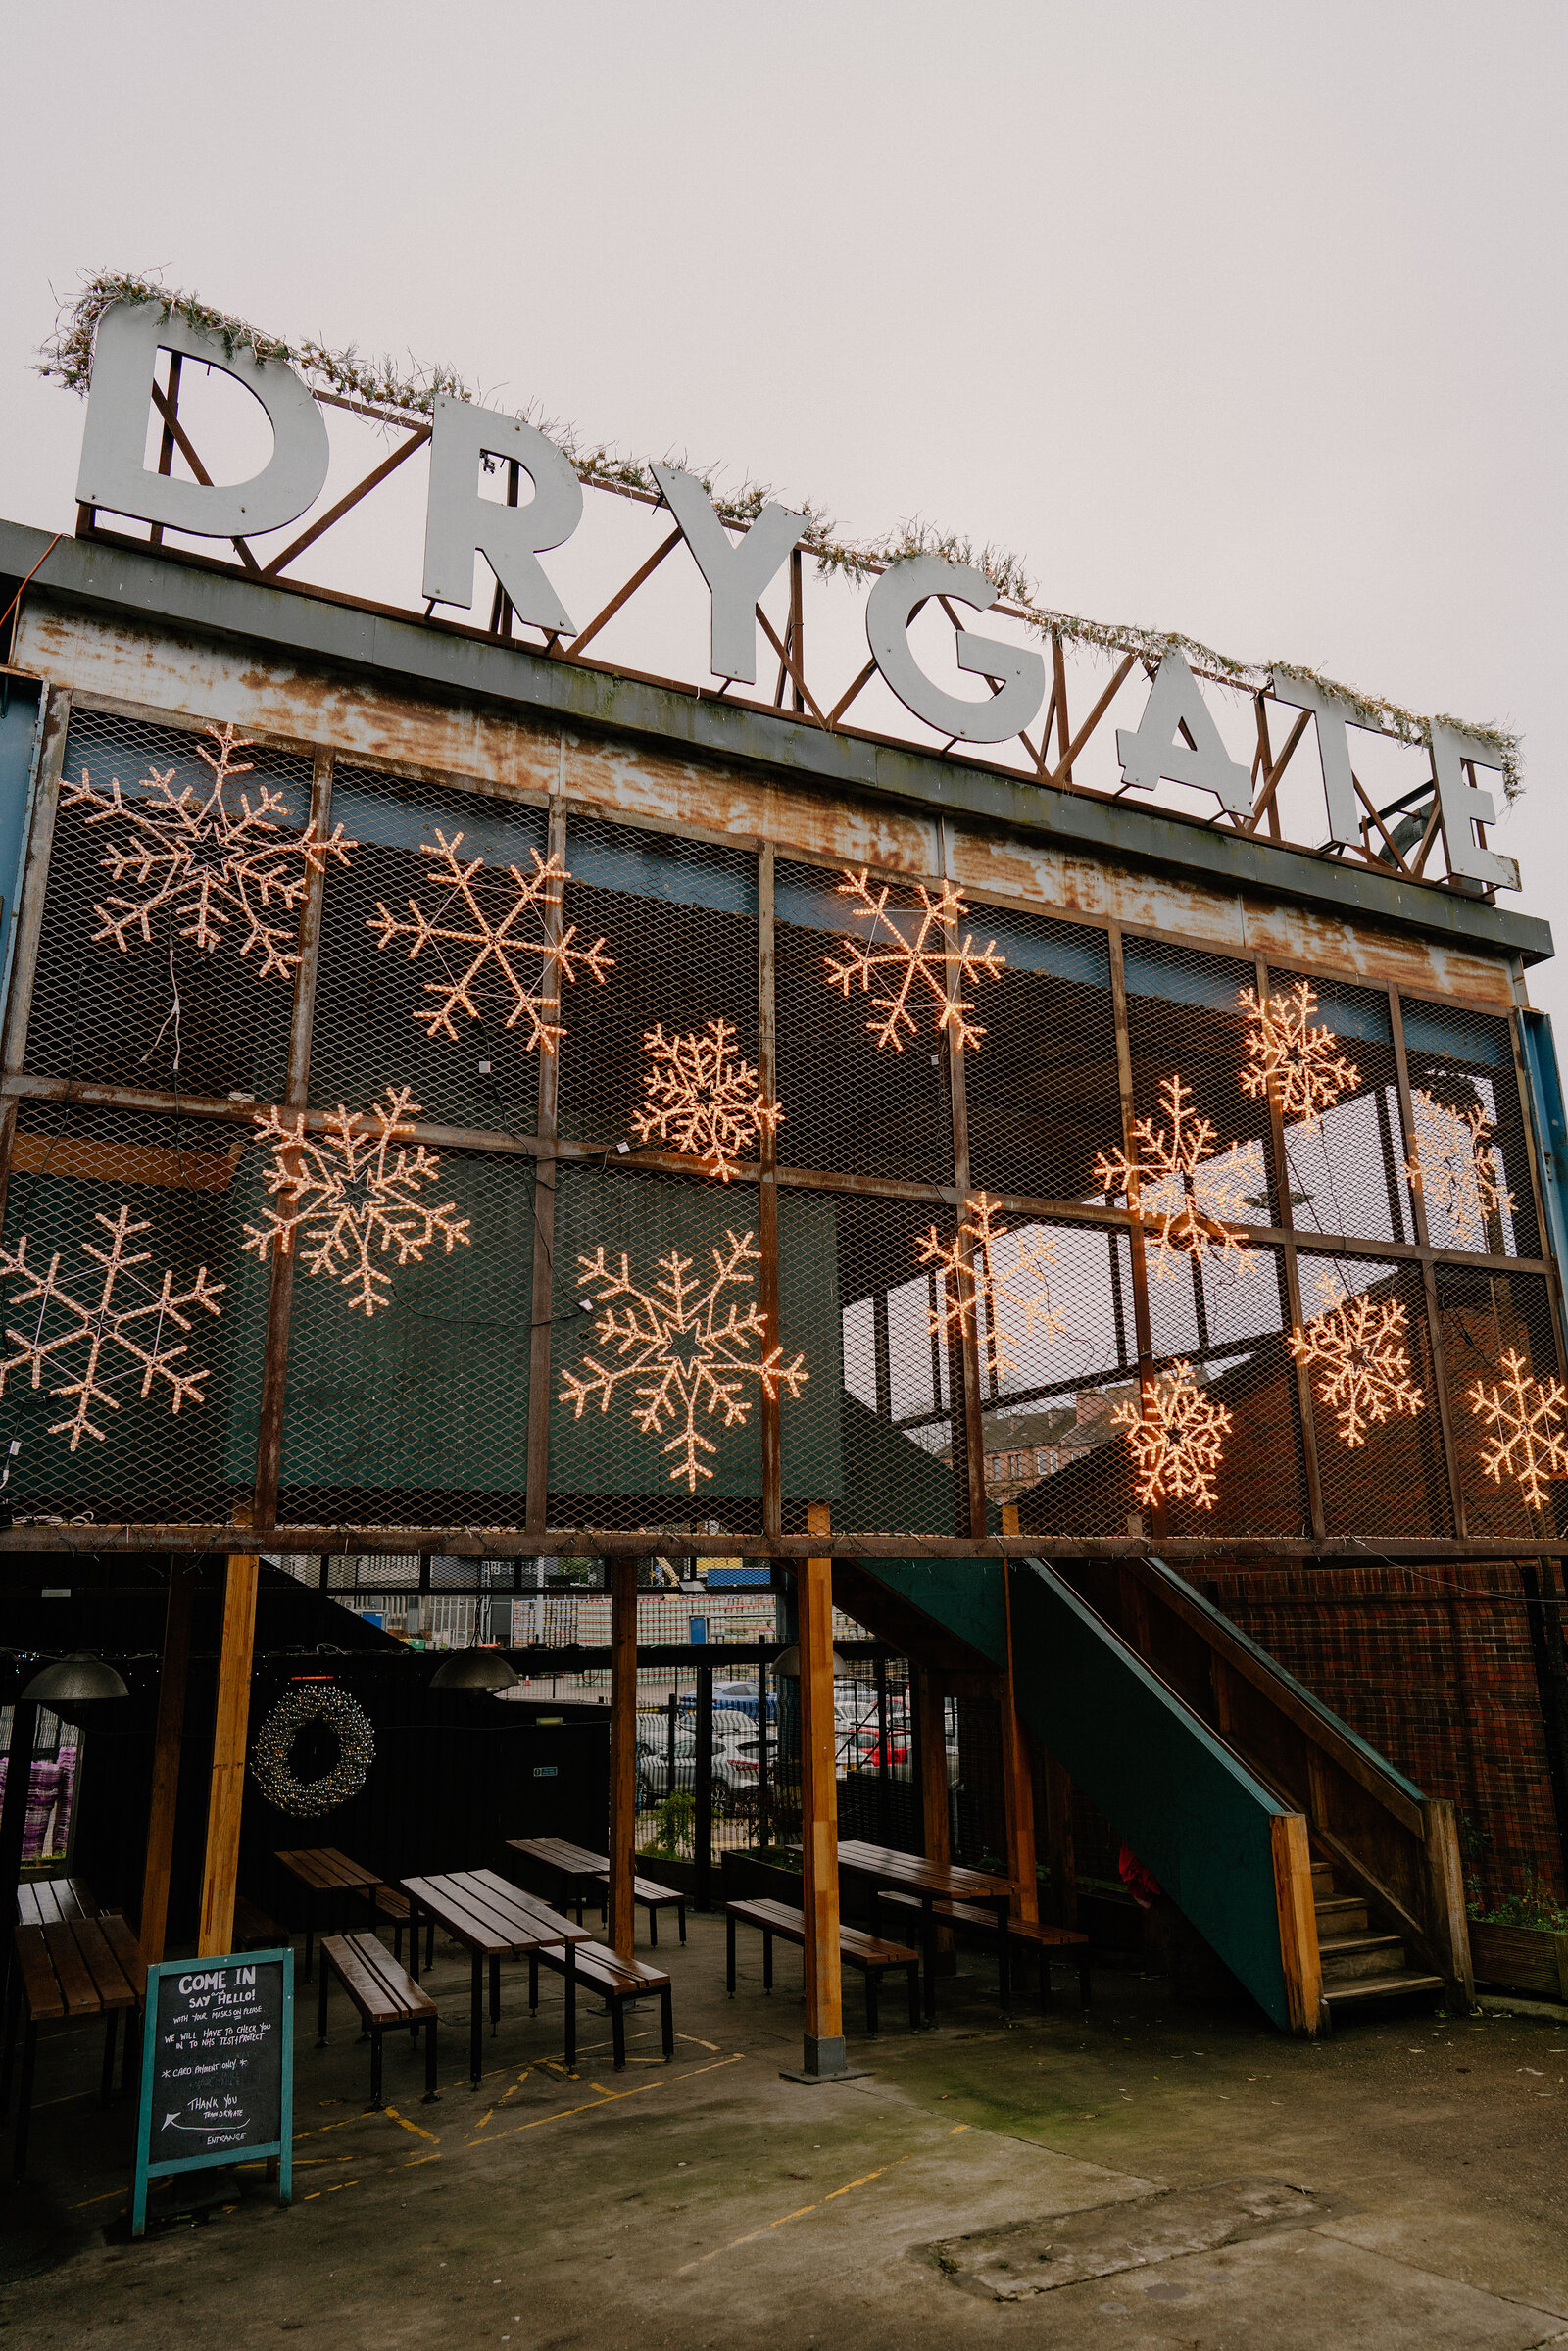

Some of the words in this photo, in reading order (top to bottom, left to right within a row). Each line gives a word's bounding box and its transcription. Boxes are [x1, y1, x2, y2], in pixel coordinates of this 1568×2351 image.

[75, 296, 1521, 892] DRYGATE
[178, 1970, 226, 1995] COME
[233, 1965, 256, 1986] IN
[189, 1995, 210, 2009] SAY
[218, 1988, 256, 2005] HELLO!
[173, 2014, 188, 2025] WITH
[192, 2012, 208, 2022] YOUR
[212, 2009, 232, 2019] MASKS
[164, 2034, 175, 2044] WE
[180, 2032, 196, 2041] WILL
[203, 2028, 223, 2038] HAVE
[224, 2027, 233, 2036] TO
[236, 2024, 257, 2033] CHECK
[259, 2022, 271, 2032] YOU
[201, 2037, 215, 2048] NHS
[172, 2066, 192, 2078] CARD
[194, 2062, 220, 2074] PAYMENT
[221, 2058, 236, 2070] ONLY
[187, 2096, 219, 2111] THANK
[223, 2094, 237, 2108] YOU
[207, 2132, 247, 2145] ENTRANCE
